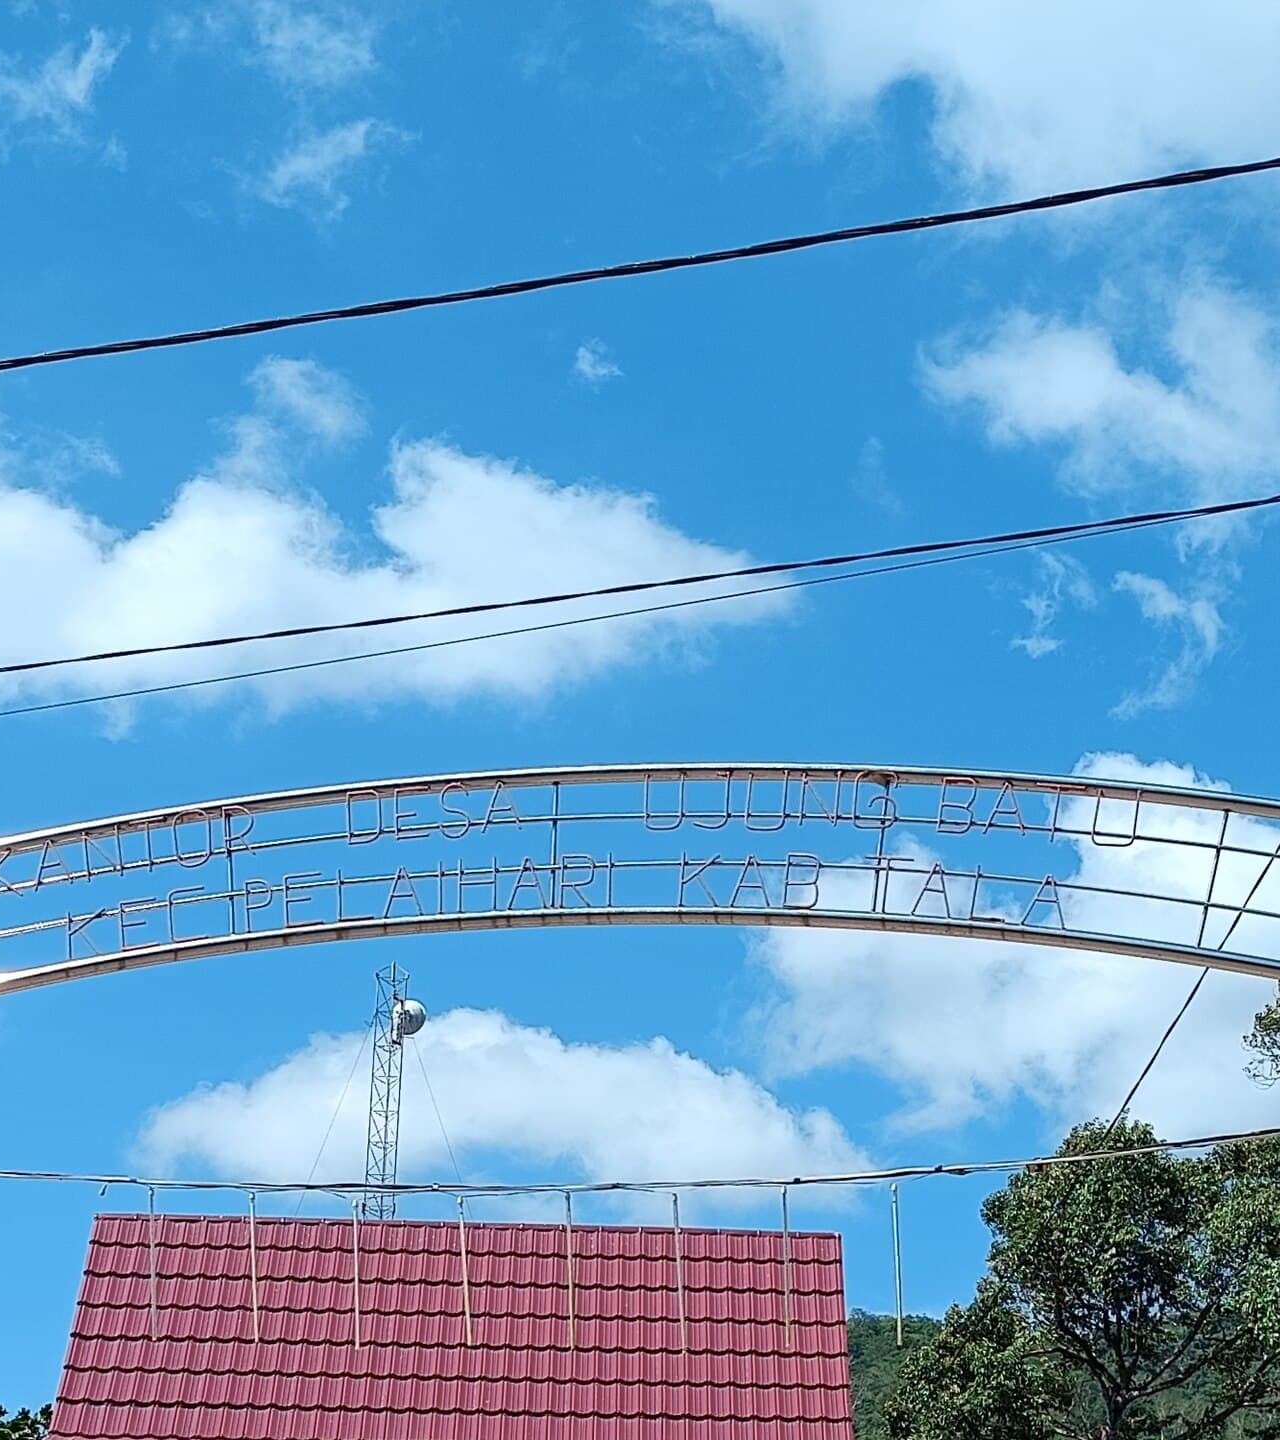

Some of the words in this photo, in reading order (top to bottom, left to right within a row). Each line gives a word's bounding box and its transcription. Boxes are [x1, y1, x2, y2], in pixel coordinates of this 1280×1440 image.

[345, 780, 522, 846] DESA
[643, 769, 898, 832] UJUNG
[935, 776, 1142, 847] BATU
[65, 885, 210, 960] KEC
[242, 851, 613, 934] PELAIHARI
[677, 852, 822, 910] KAB
[865, 855, 1066, 930] TALA
